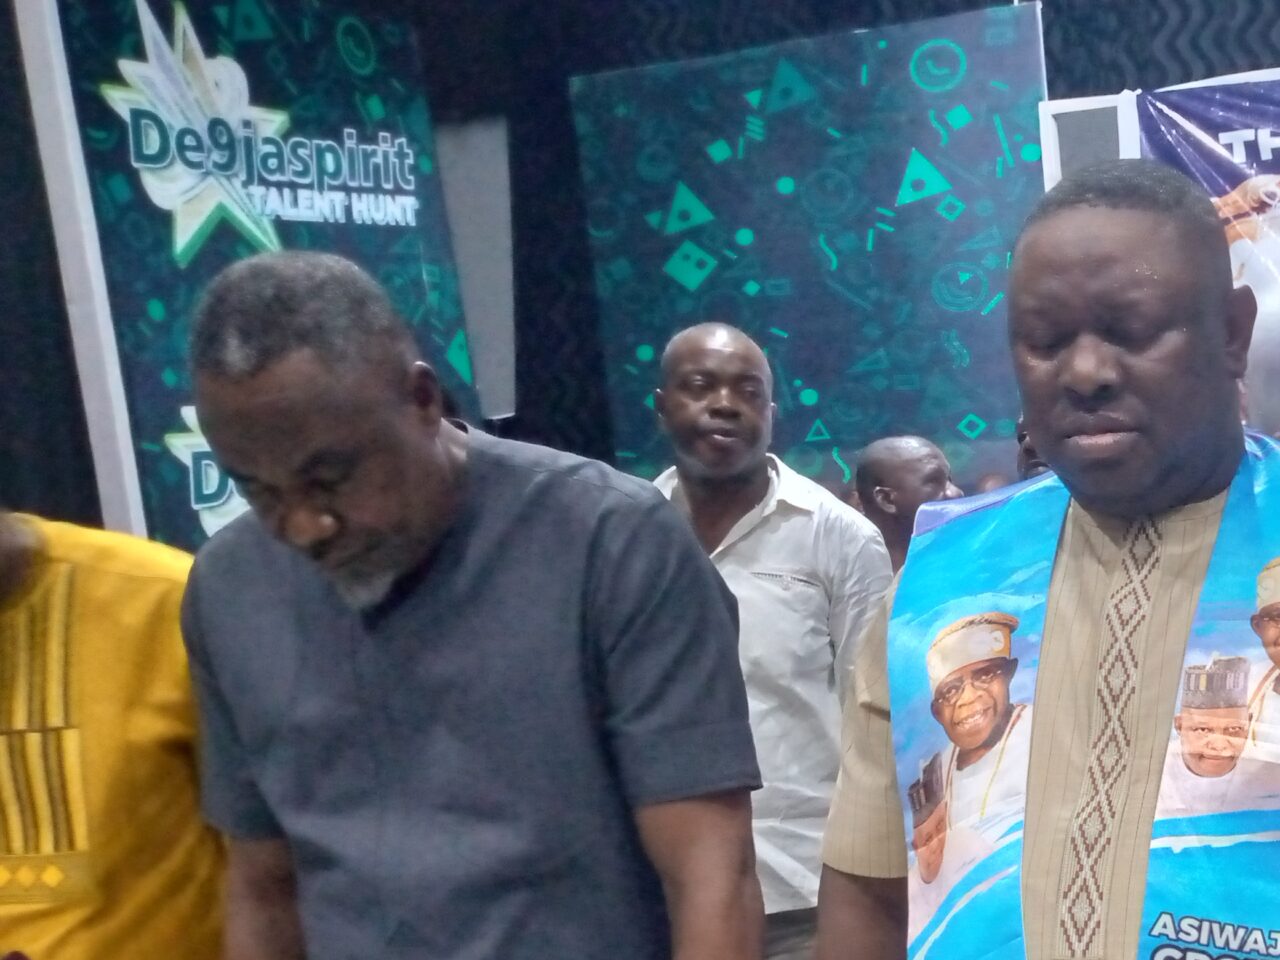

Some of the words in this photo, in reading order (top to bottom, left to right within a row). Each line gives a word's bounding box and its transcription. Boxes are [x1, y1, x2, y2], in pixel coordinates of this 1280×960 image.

[129, 107, 415, 190] De9jaspirit
[248, 185, 349, 223] TALENT
[351, 193, 418, 226] HUNT
